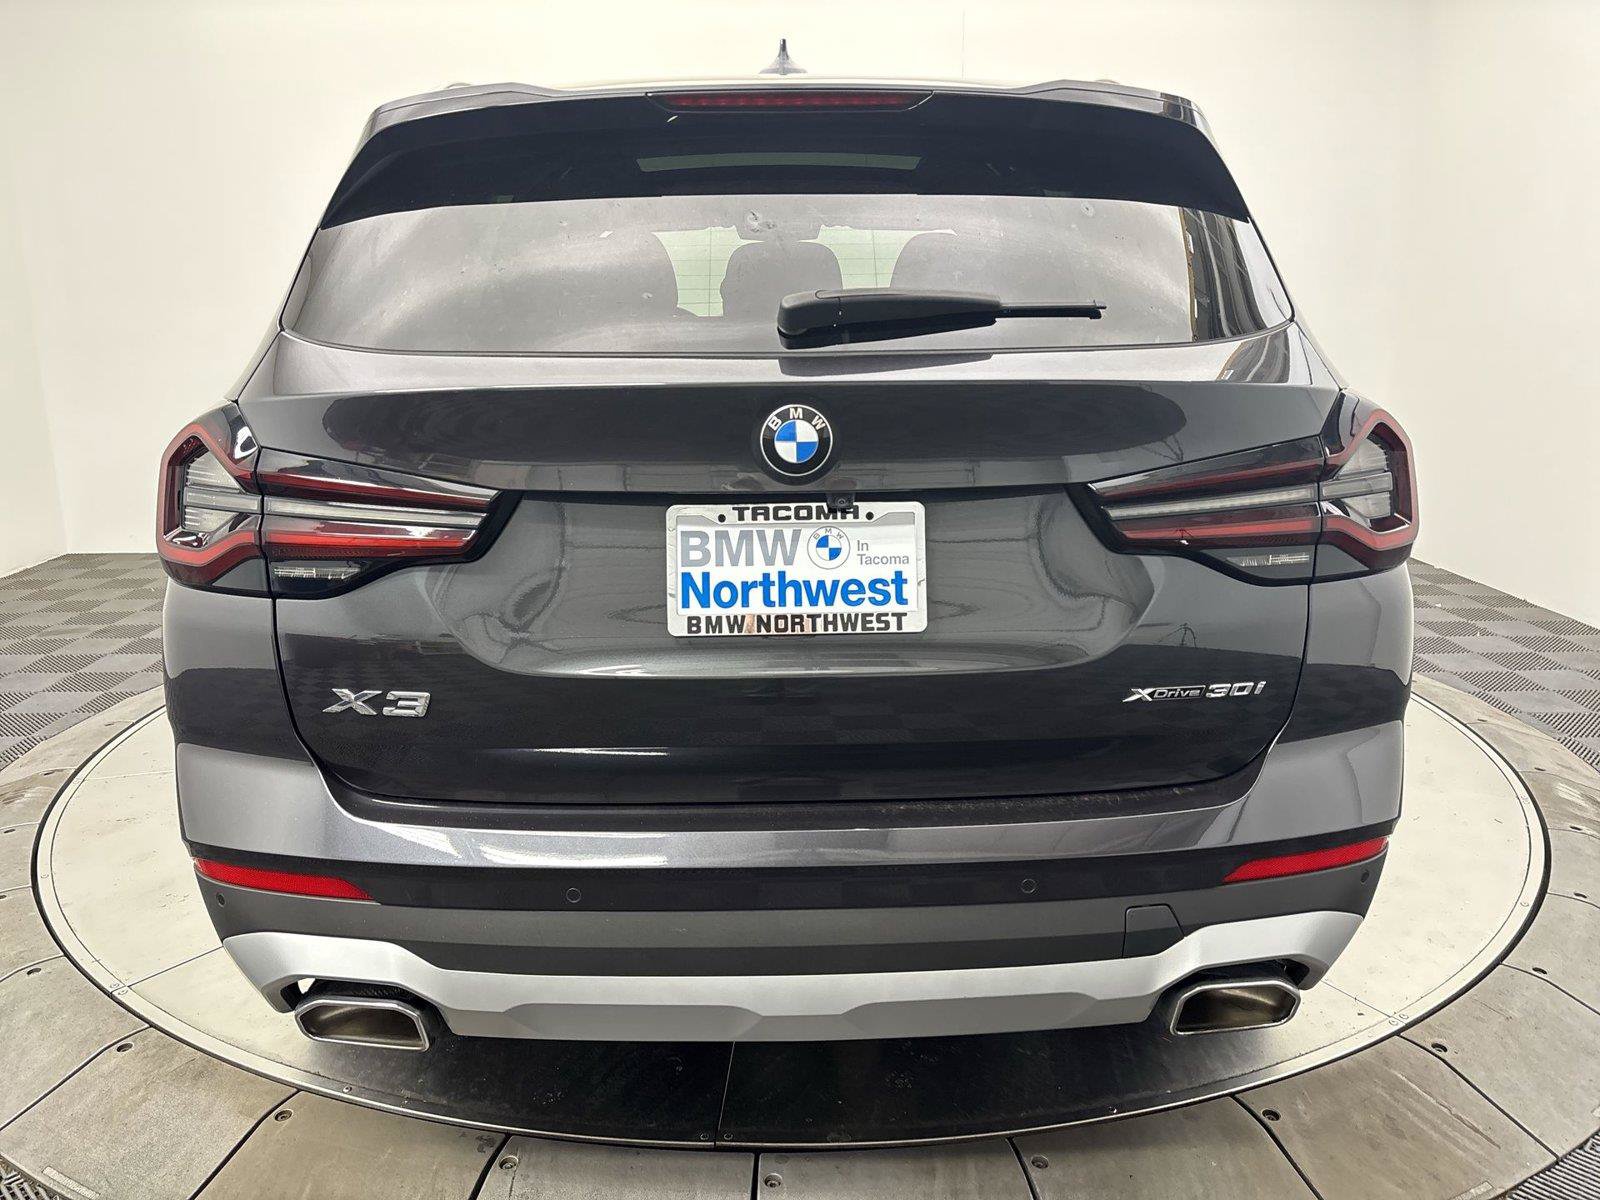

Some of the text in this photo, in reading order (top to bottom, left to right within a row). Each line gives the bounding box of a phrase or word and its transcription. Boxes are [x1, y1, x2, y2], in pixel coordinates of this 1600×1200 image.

[768, 407, 826, 431] BMW
[732, 504, 859, 521] TACOMA
[813, 528, 844, 540] BMW
[680, 529, 802, 567] BMW
[857, 540, 869, 551] In
[857, 554, 910, 565] Tacoma
[681, 570, 909, 609] Northwest
[687, 613, 908, 634] BMW NORTHWEST
[322, 688, 430, 717] X3
